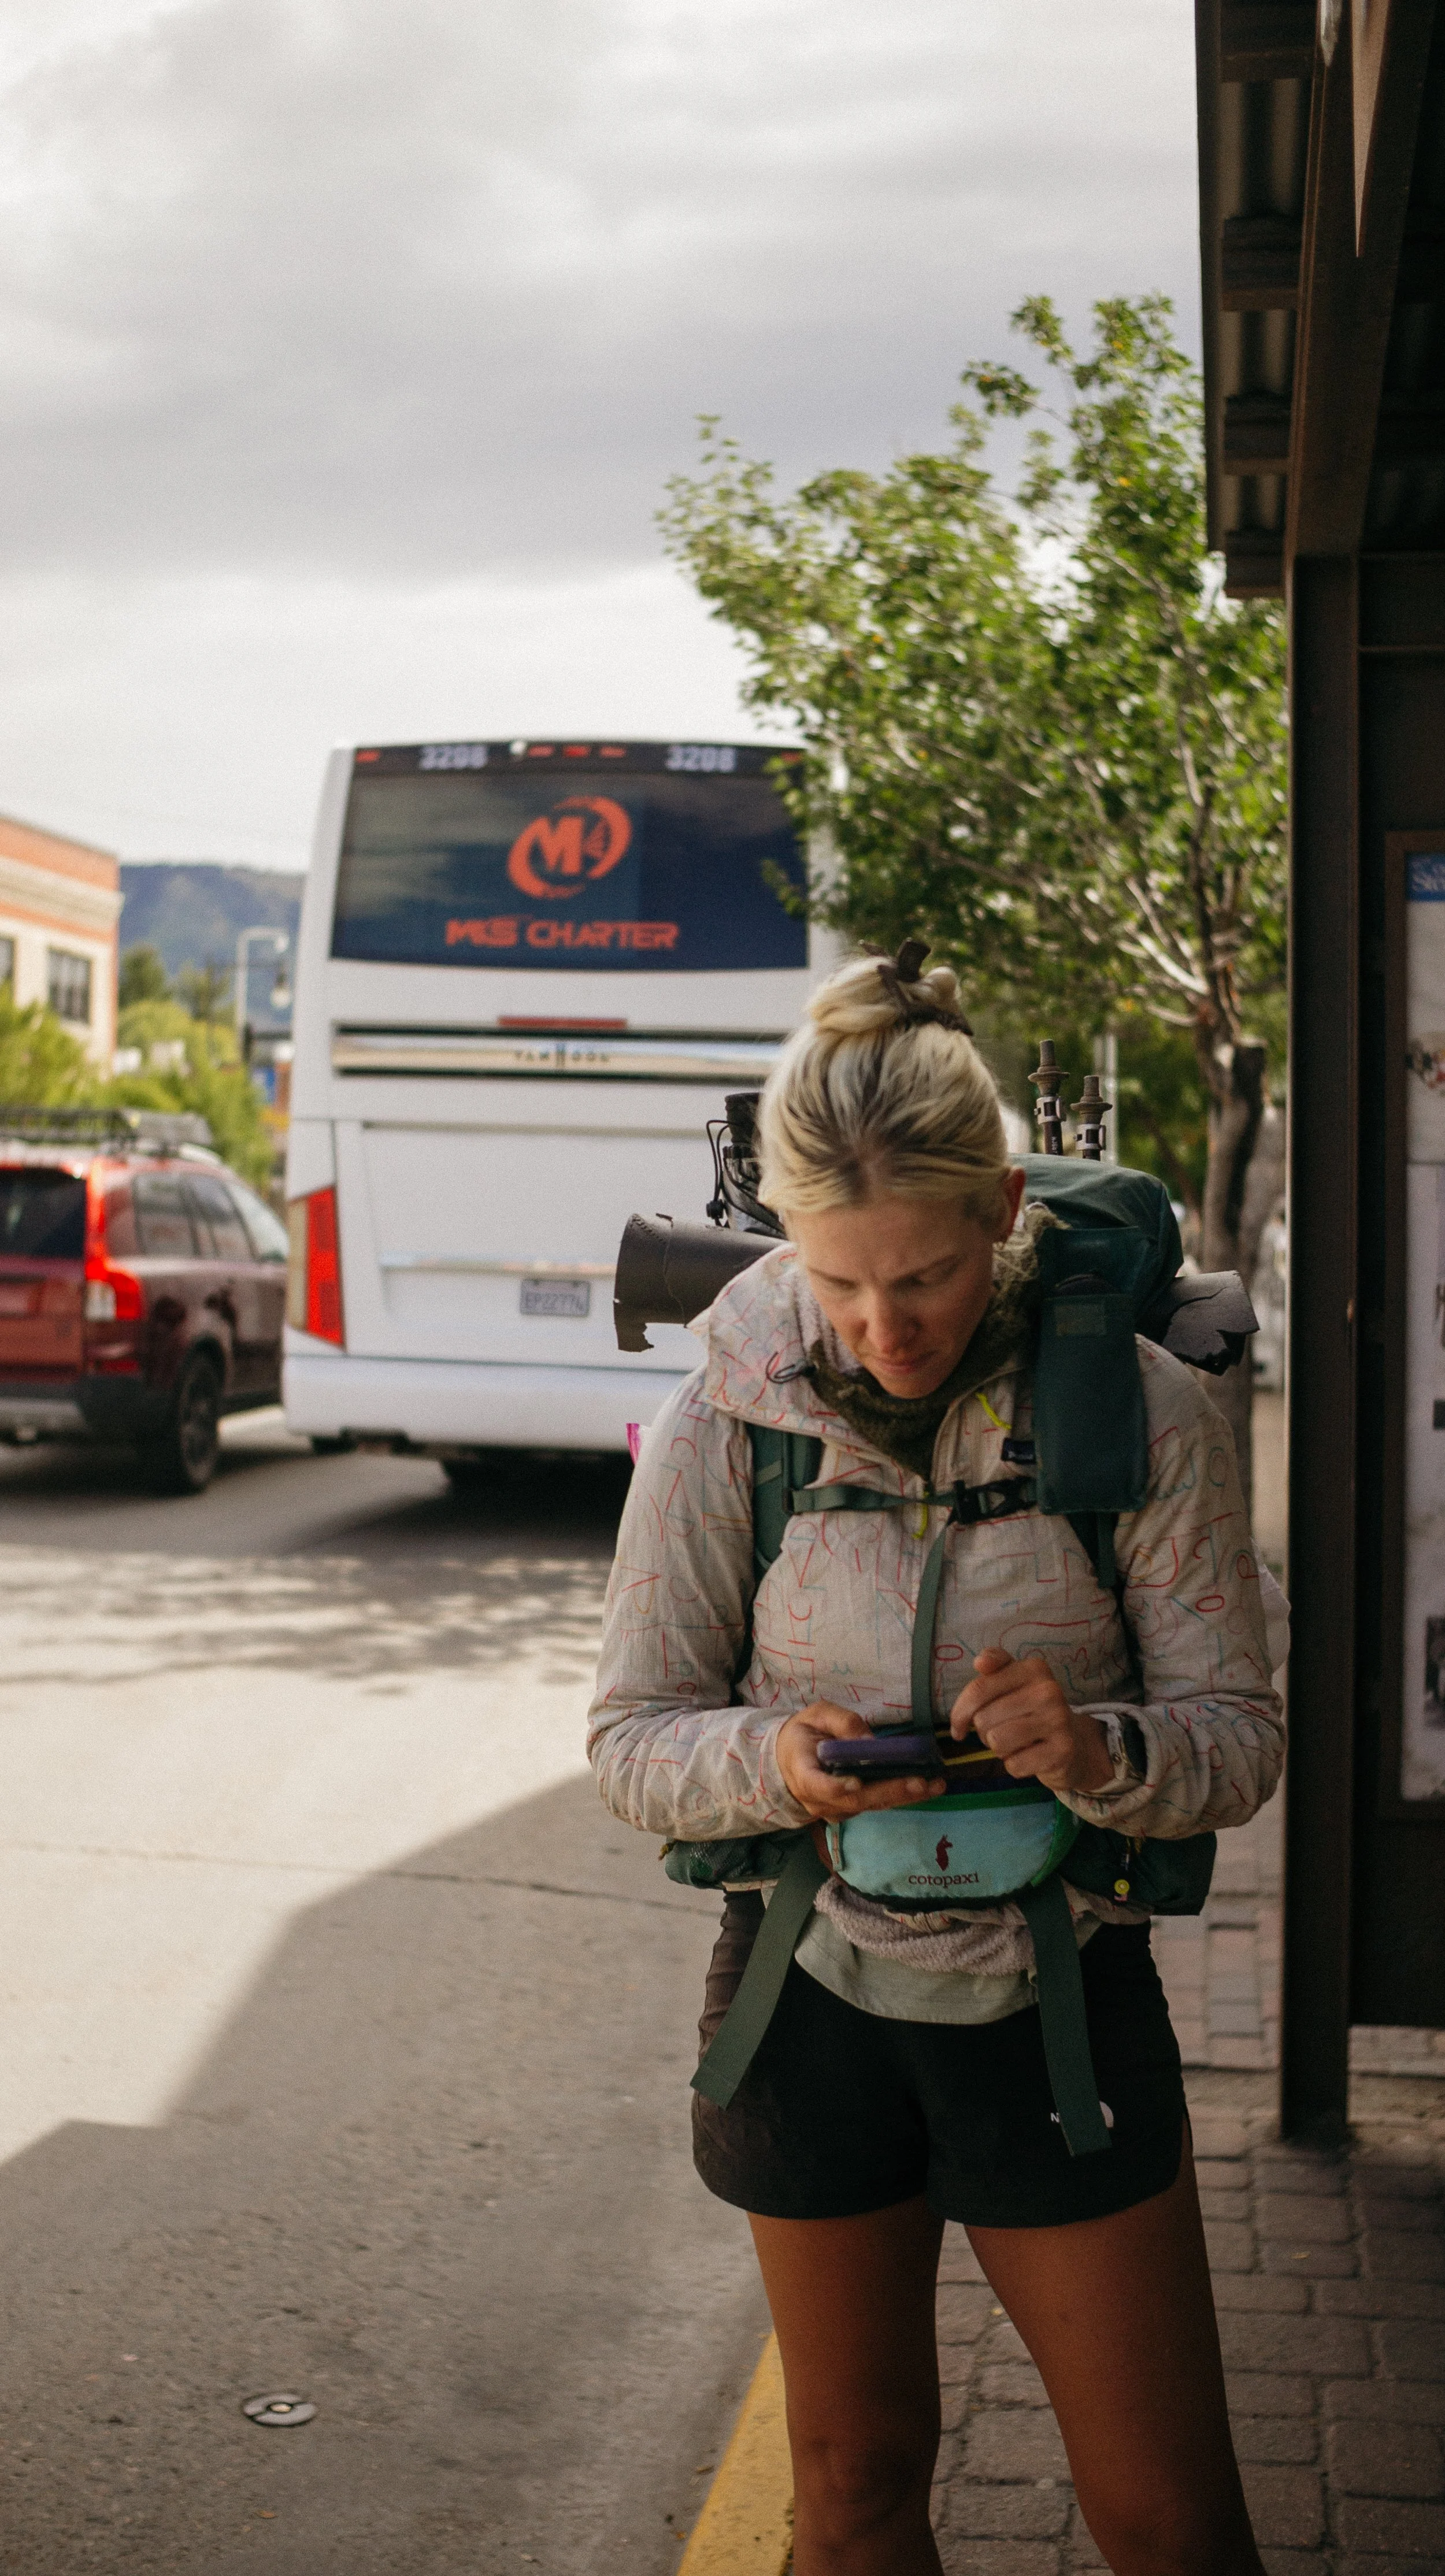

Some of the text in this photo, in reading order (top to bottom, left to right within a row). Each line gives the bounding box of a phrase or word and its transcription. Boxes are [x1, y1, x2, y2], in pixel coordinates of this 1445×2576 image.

[665, 746, 736, 772] 3208
[525, 920, 679, 949] CHARTER
[908, 1871, 979, 1889] cotopaxi
